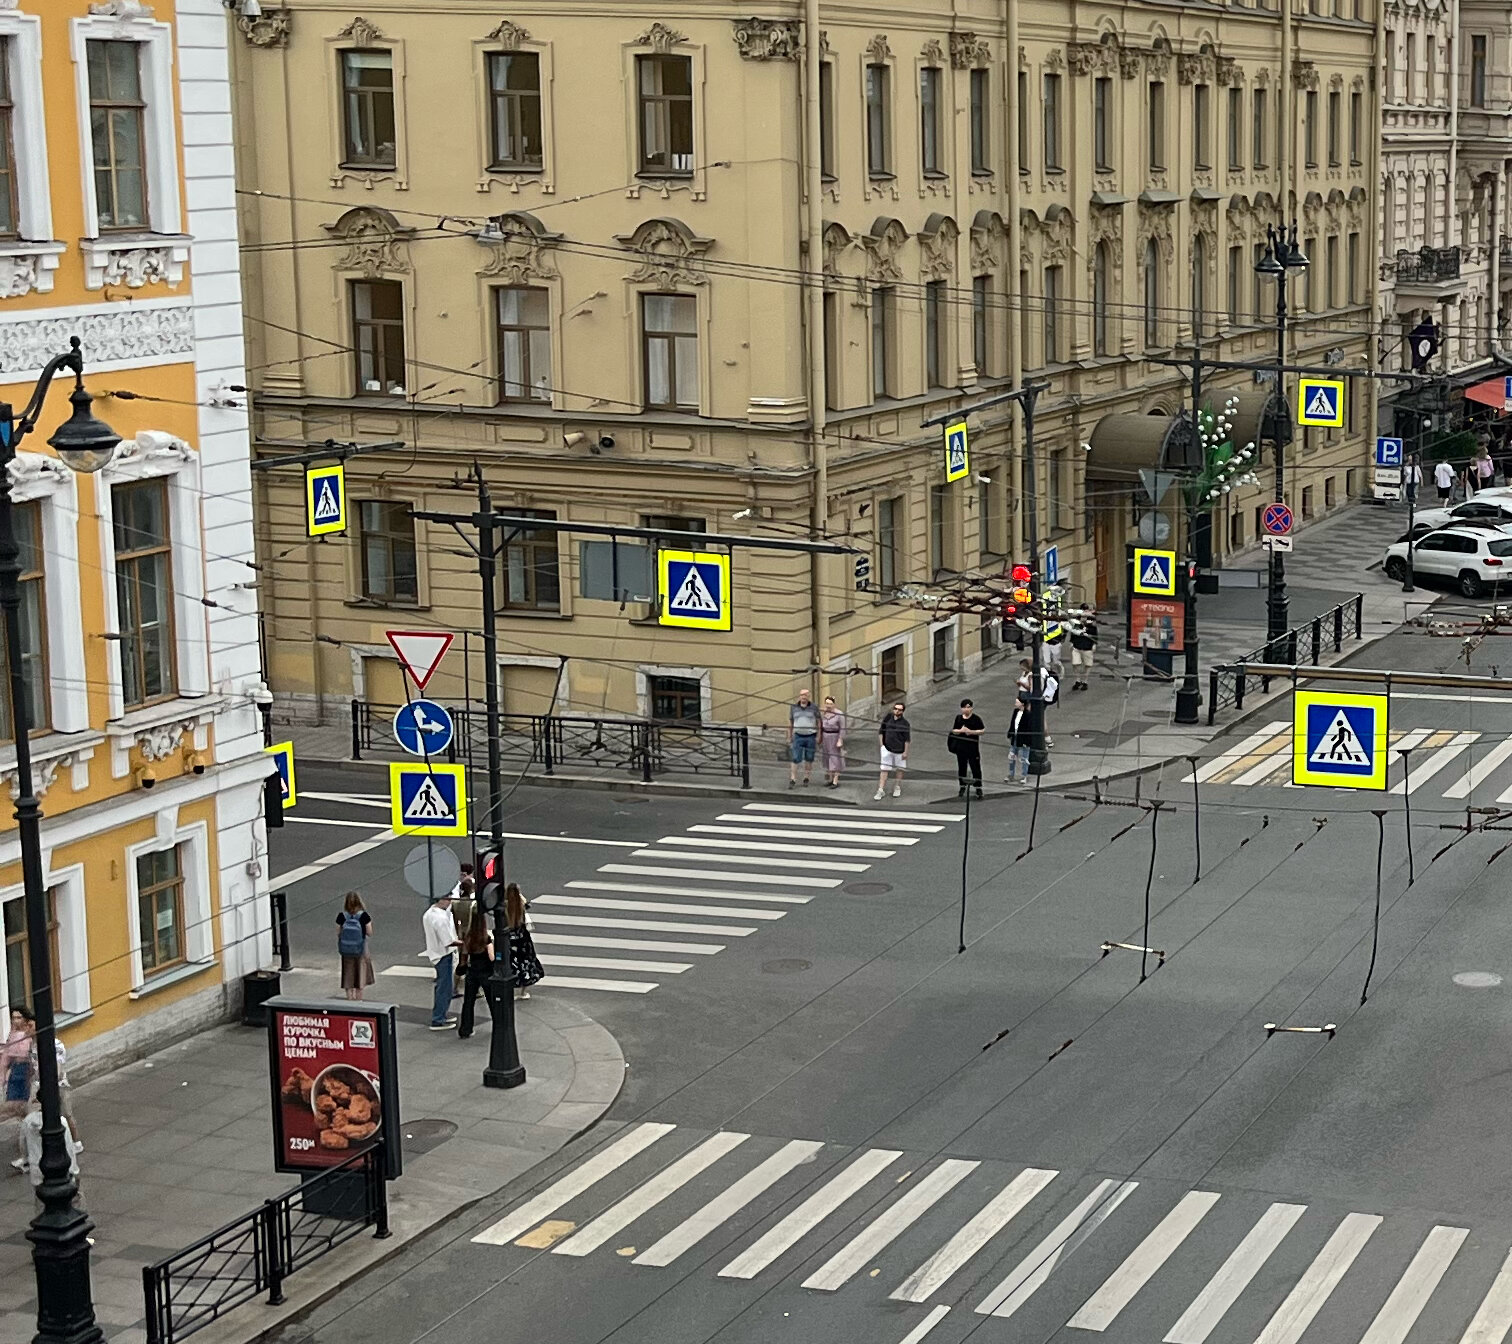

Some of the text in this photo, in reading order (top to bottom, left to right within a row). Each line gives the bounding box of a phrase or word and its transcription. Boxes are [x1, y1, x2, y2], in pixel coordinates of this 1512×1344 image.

[1382, 441, 1397, 462] P
[283, 1015, 329, 1028] ЛЮБИМАЯ
[283, 1026, 326, 1038] КУРОЧКА
[284, 1037, 297, 1046] ПО
[299, 1037, 344, 1050] ВКУСНЫМ
[284, 1047, 317, 1058] ЦЕНАМ
